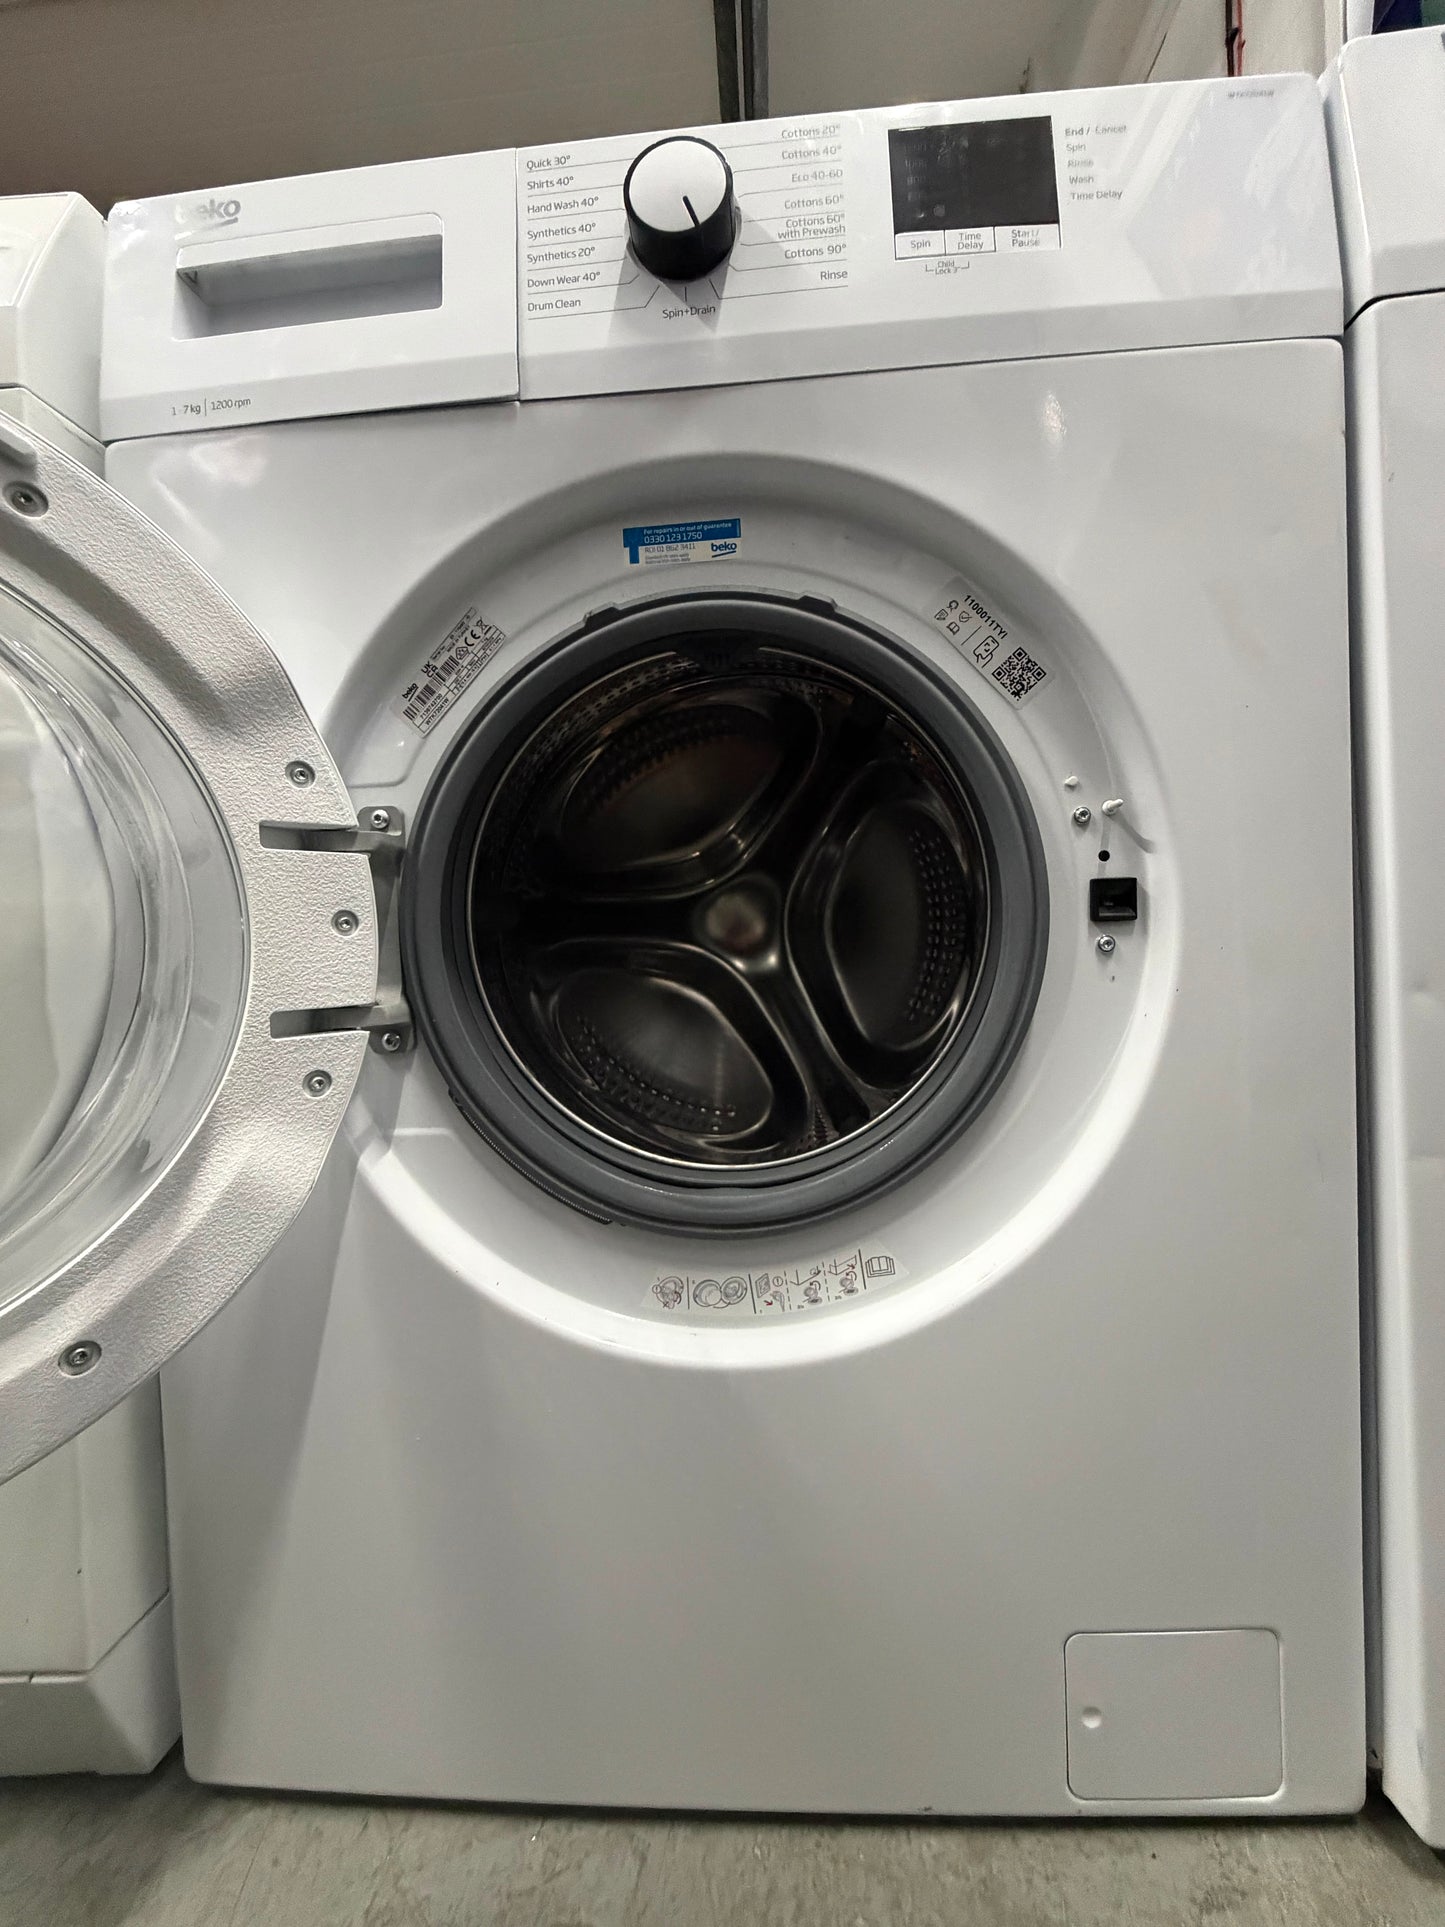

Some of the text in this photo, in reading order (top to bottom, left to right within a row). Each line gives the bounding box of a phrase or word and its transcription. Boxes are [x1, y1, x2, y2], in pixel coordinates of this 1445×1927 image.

[782, 128, 819, 138] Cottons
[1065, 128, 1083, 136] End
[1066, 144, 1086, 152] Spin
[782, 149, 820, 160] Cottons
[527, 158, 551, 170] Quick
[792, 169, 843, 182] Eco 40-60
[1069, 176, 1094, 184] Wash
[527, 180, 554, 190] Shirts
[1096, 190, 1122, 200] Delay
[528, 203, 551, 214] Hand
[554, 200, 579, 210] Wash
[785, 198, 823, 209] Cottons
[786, 218, 825, 228] Cottons
[527, 226, 576, 240] Synthetics
[778, 225, 845, 239] with Prewash
[959, 233, 981, 241] Time
[911, 240, 931, 250] Spin
[958, 241, 984, 250] Delay
[1012, 239, 1040, 247] Pause
[527, 250, 576, 264] Synthetics
[785, 249, 823, 259] Cottons
[820, 270, 848, 280] Rinse
[528, 278, 554, 288] Down
[557, 275, 580, 284] Wear
[528, 300, 580, 311] Drum Clean
[663, 305, 715, 319] Spin+Drain
[211, 399, 251, 410] 1200 rpm
[644, 535, 665, 543] 0330
[711, 542, 737, 551] beko
[964, 595, 1008, 639] 1100011TYI
[402, 683, 417, 698] beko
